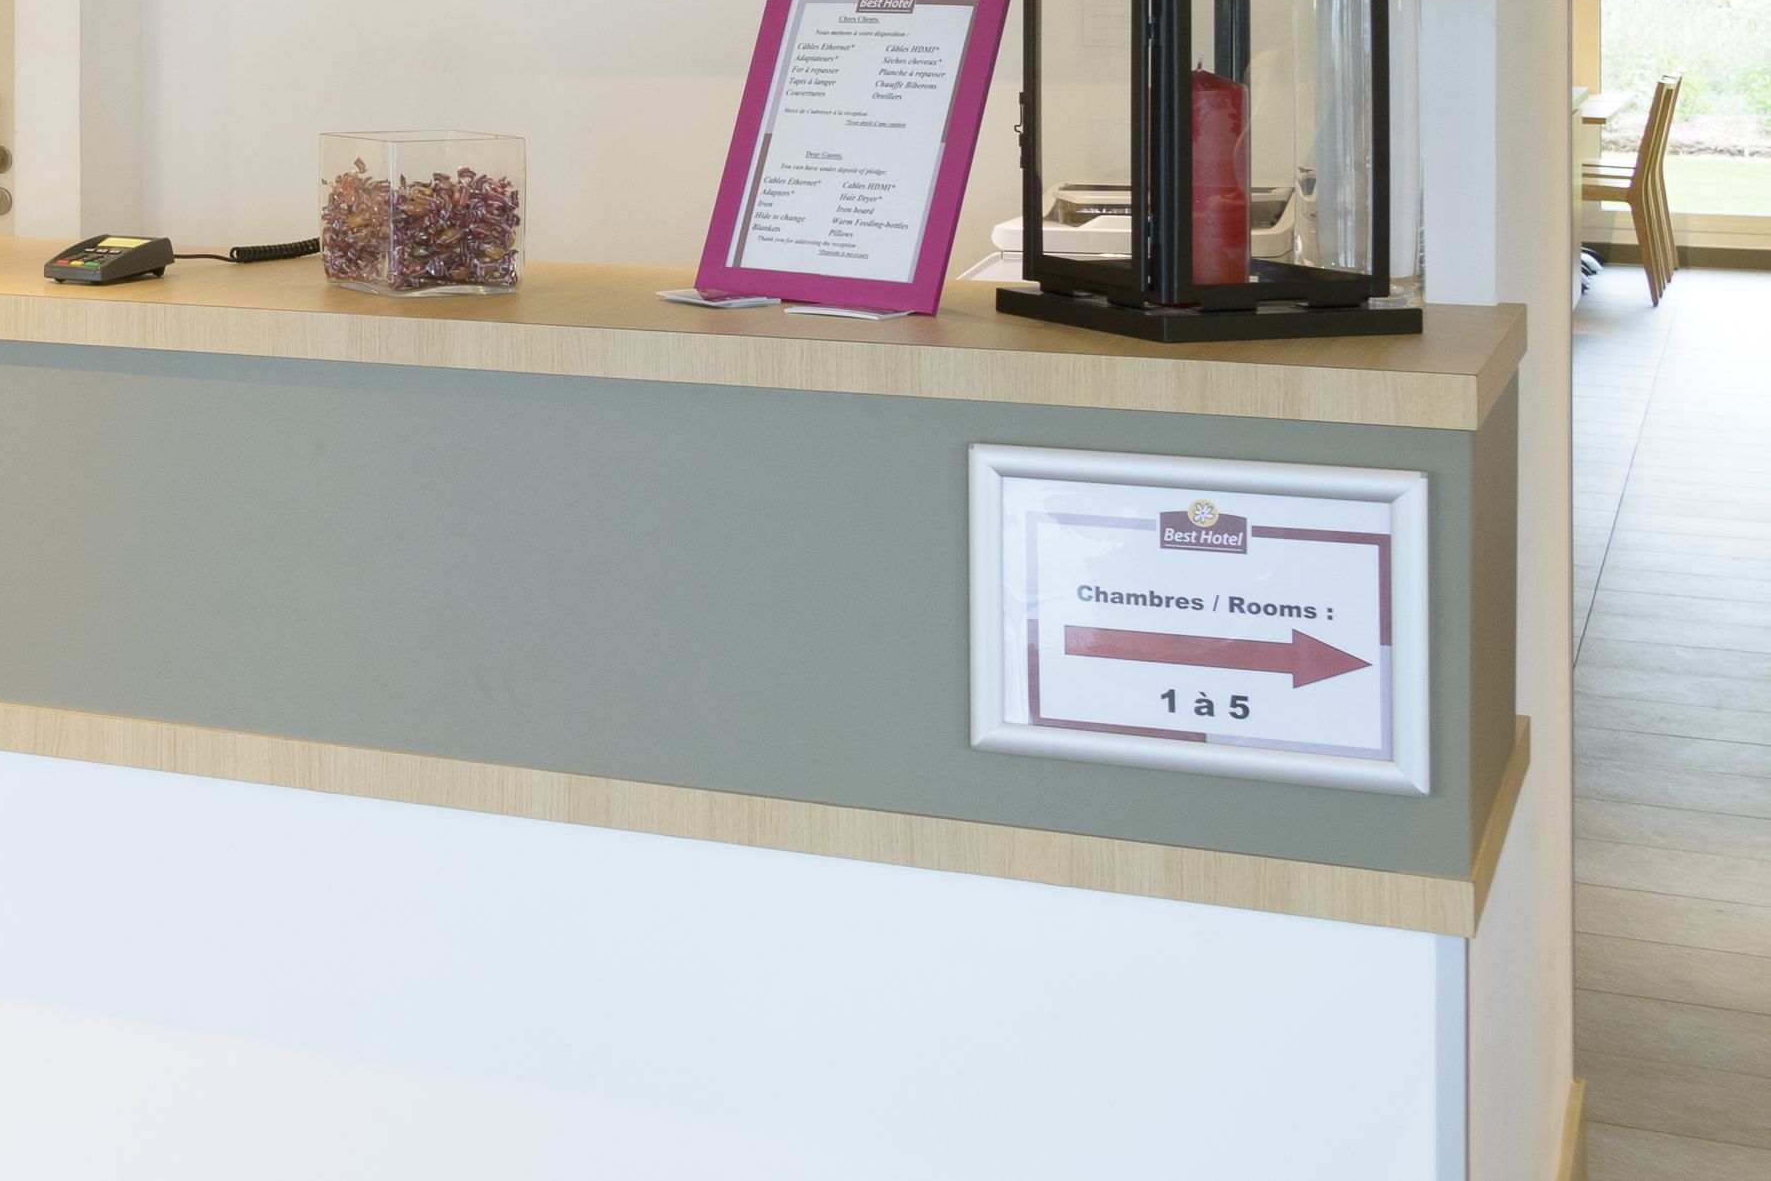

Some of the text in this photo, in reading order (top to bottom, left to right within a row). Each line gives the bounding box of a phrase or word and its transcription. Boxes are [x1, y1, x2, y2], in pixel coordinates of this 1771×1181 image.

[797, 43, 819, 51] Câbles
[886, 45, 909, 53] Câbles
[837, 206, 874, 214] Iron board
[1164, 527, 1243, 547] Best Hotel
[1077, 585, 1204, 611] Chambres
[1213, 595, 1219, 611] /
[1228, 597, 1317, 619] Rooms
[1160, 690, 1250, 719] 1 à 5
